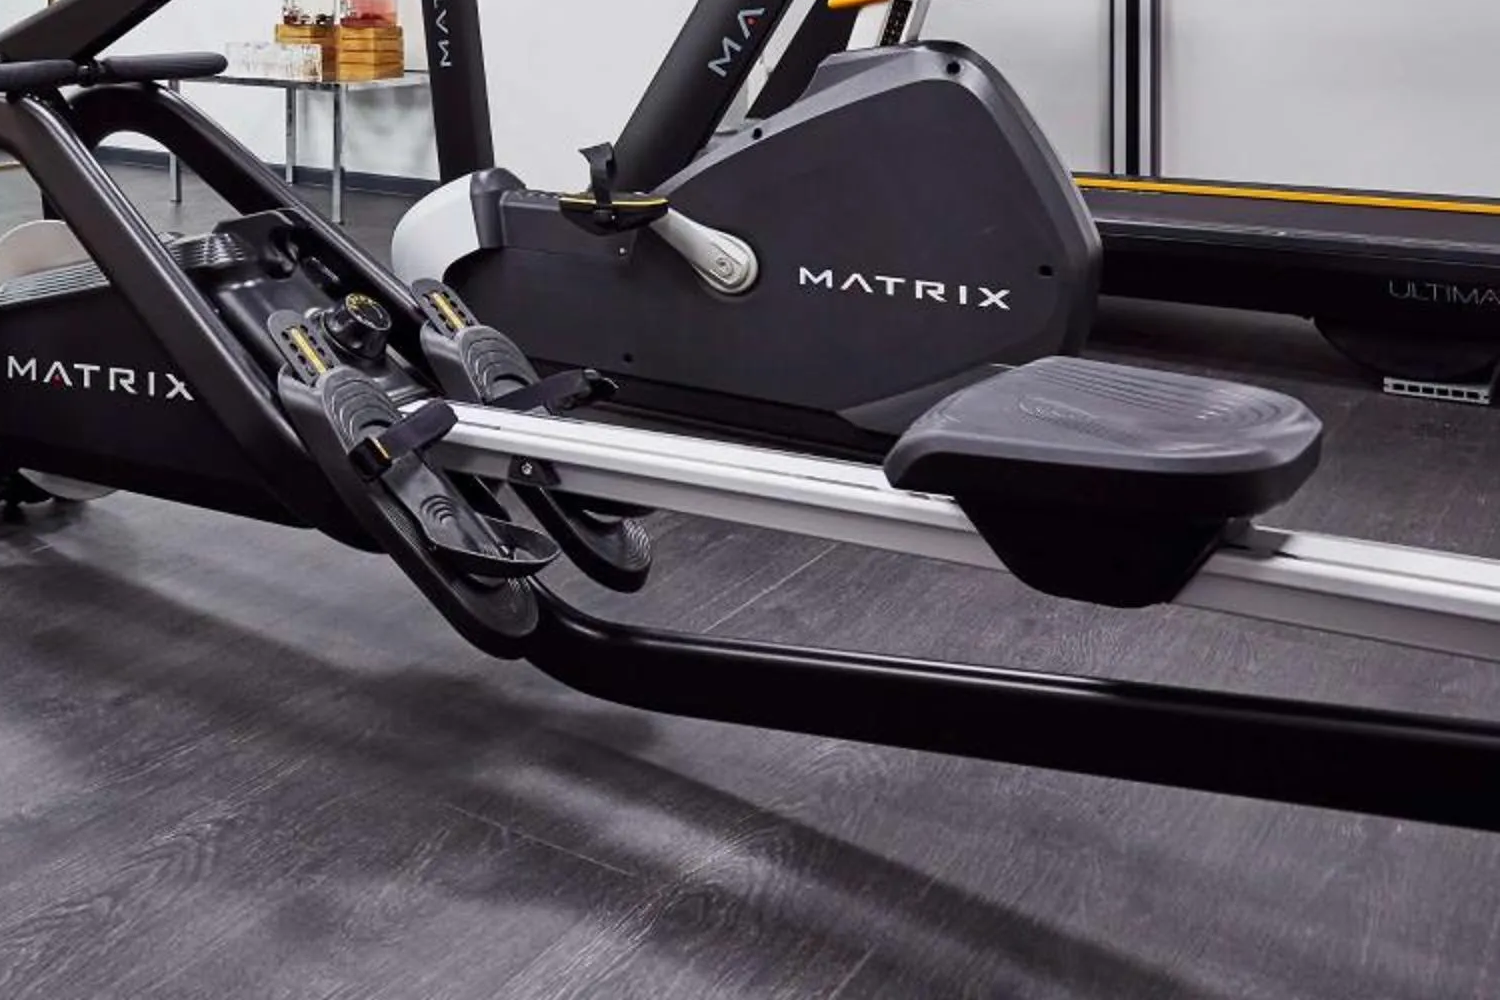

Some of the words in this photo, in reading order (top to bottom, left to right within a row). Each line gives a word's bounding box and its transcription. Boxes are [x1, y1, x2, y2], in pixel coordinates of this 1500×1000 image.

[799, 265, 1011, 311] MATRIX
[1388, 279, 1500, 305] ULTIMA
[7, 355, 195, 401] MATRIX
